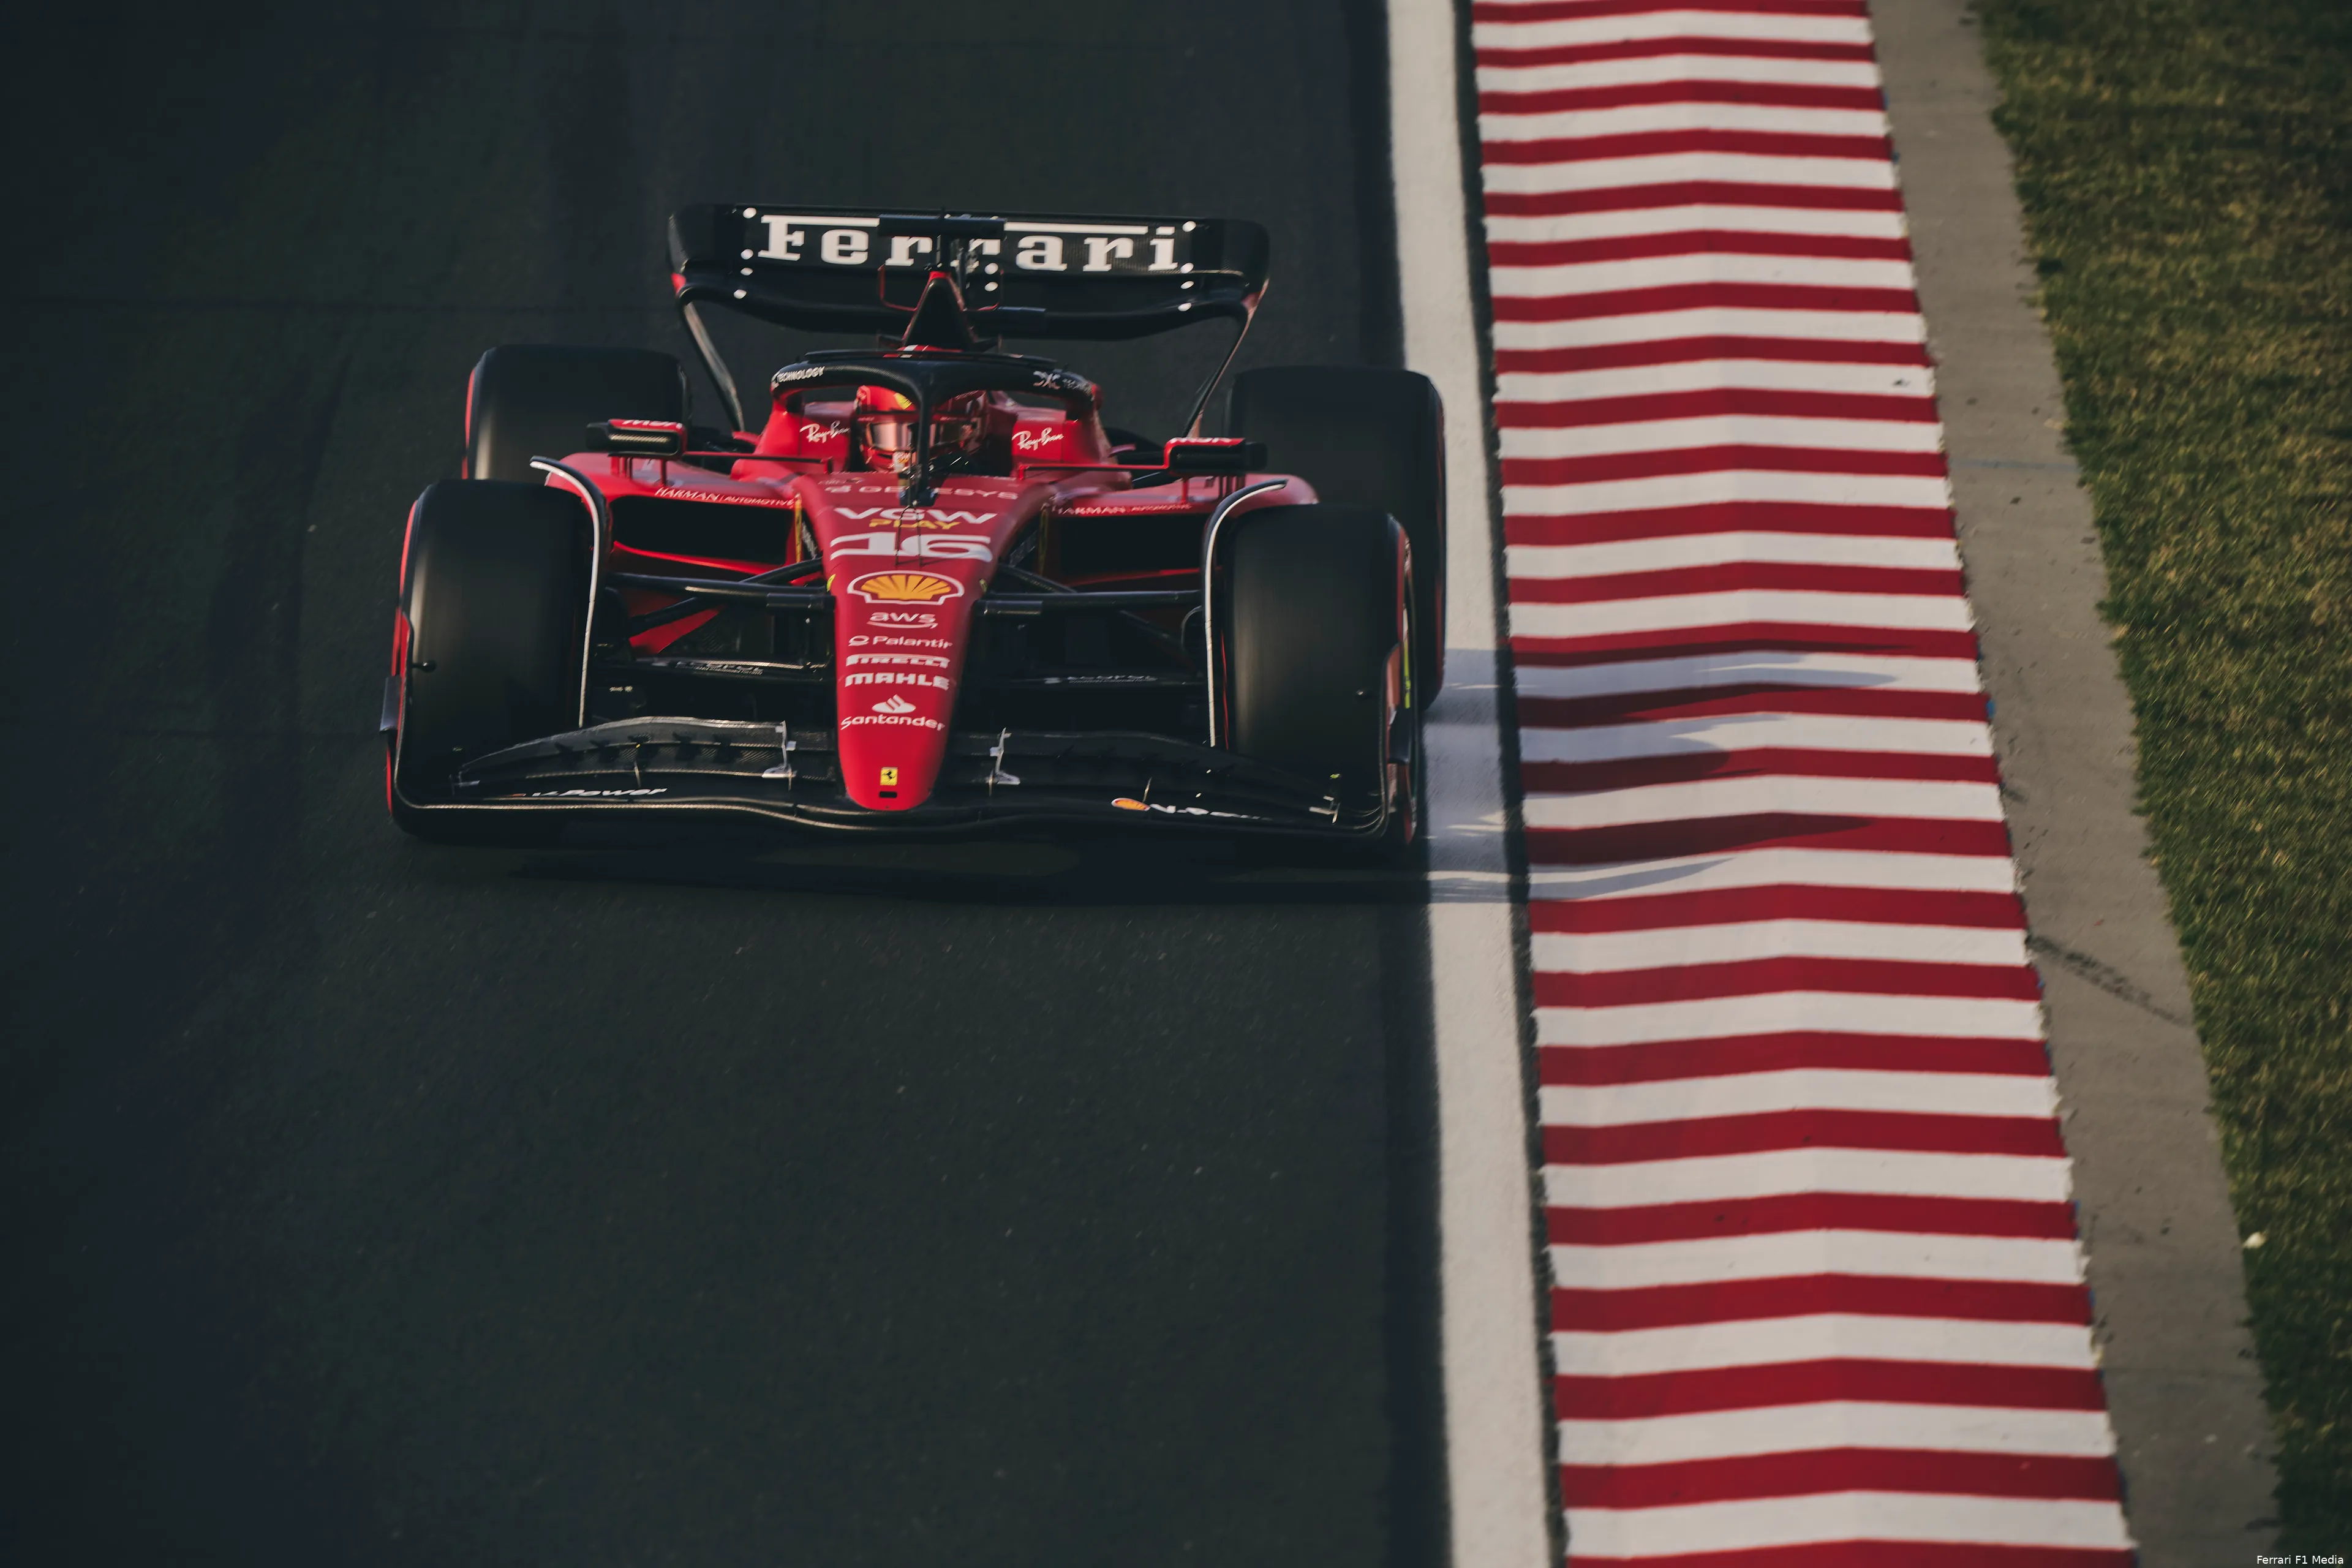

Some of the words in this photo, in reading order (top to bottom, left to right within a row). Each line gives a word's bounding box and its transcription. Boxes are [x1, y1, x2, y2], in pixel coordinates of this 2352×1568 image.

[655, 487, 720, 502] HARMAN
[859, 486, 1019, 499] GEESYS
[834, 507, 999, 524] VGW
[869, 518, 962, 530] PLAY
[830, 532, 993, 563] 16
[870, 612, 936, 624] aws
[873, 635, 953, 649] Palantir
[846, 653, 950, 669] PIRELLI
[845, 673, 949, 691] MAHLE
[840, 714, 946, 731] Santander
